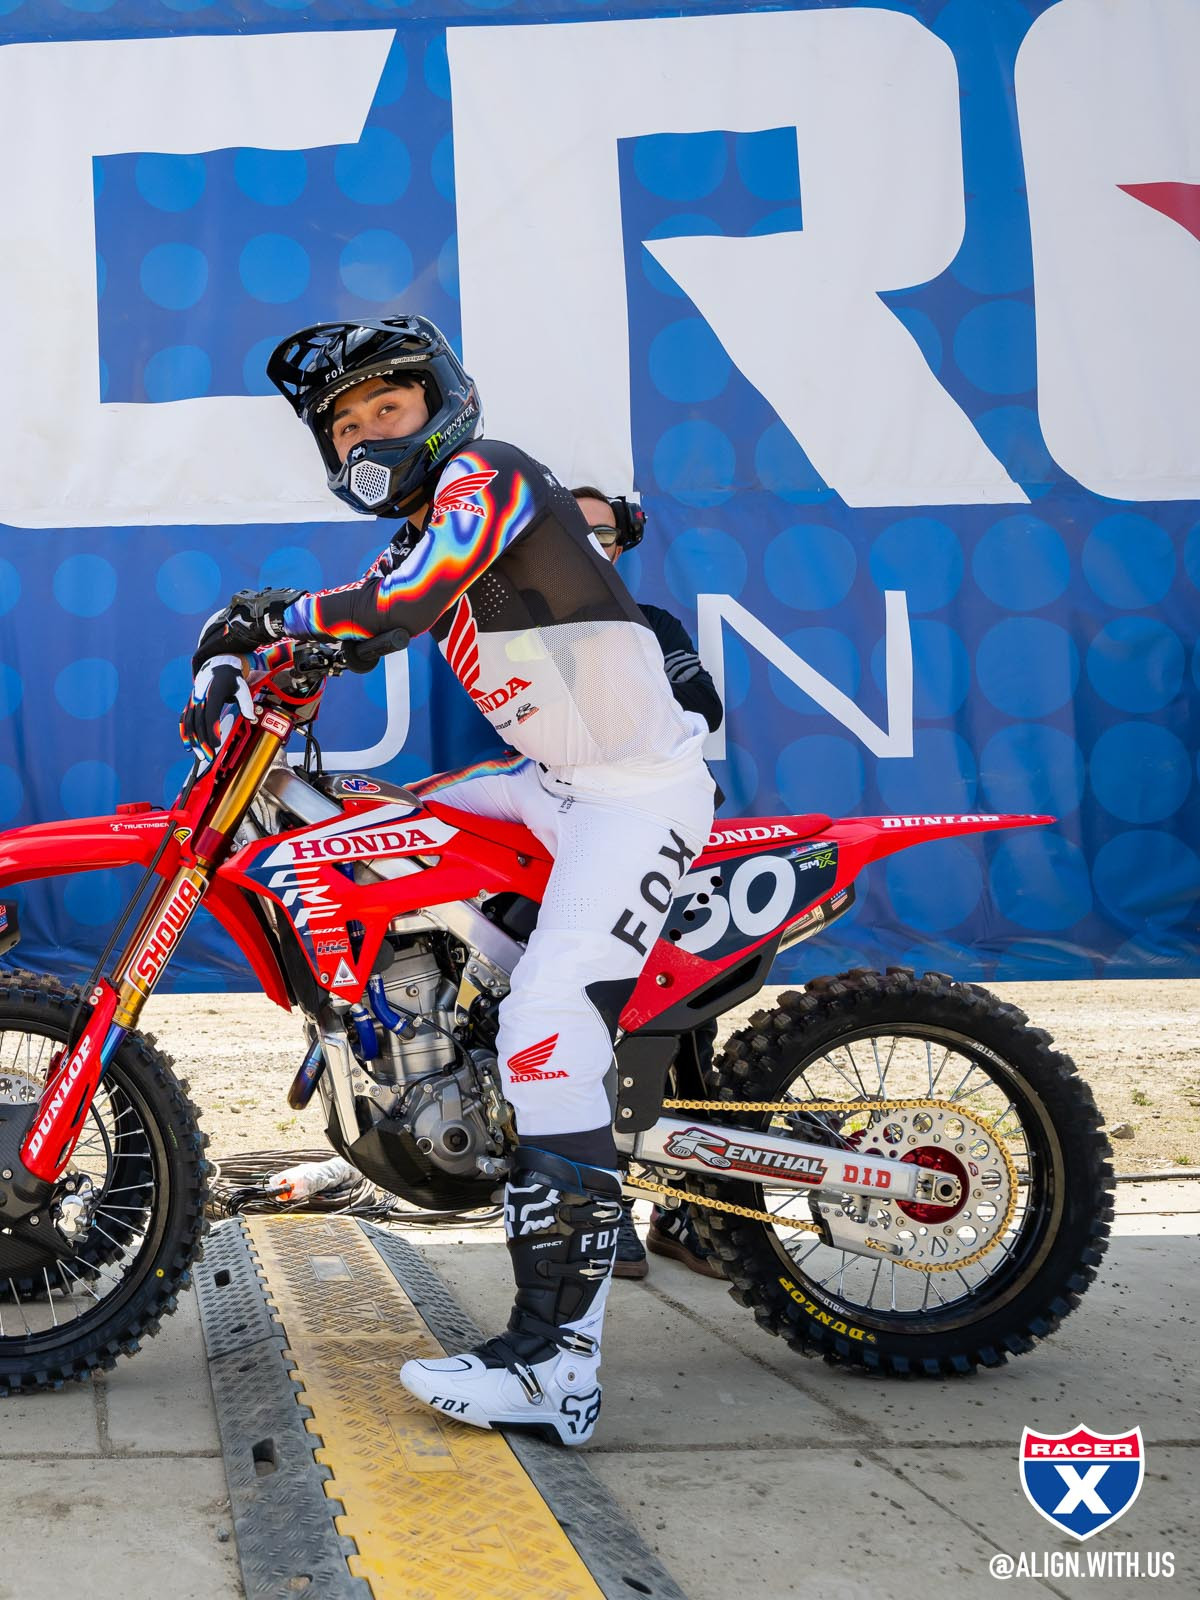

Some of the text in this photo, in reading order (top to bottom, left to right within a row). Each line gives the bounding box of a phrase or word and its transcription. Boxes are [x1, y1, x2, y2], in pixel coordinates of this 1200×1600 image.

[325, 366, 345, 383] FOX
[316, 370, 394, 414] SHIMODA
[439, 404, 475, 442] MONSTER
[447, 419, 474, 445] ENERGY
[265, 716, 288, 733] GET
[288, 828, 437, 861] HONDA
[707, 824, 798, 847] ONDA
[799, 850, 837, 871] SMX
[268, 866, 342, 929] CRF
[611, 828, 696, 957] FOX
[135, 877, 201, 985] SHOWA
[303, 926, 346, 936] 250R
[317, 938, 350, 956] HRC
[509, 1069, 569, 1084] HONDA
[28, 1034, 92, 1158] DUNLOP
[666, 1129, 825, 1176] RENTHAL
[843, 1164, 892, 1189] D.I.D
[531, 1240, 564, 1250] INSTINCT
[581, 1227, 620, 1253] FOX
[779, 1277, 866, 1341] DUNLOP
[429, 1396, 470, 1415] FOX
